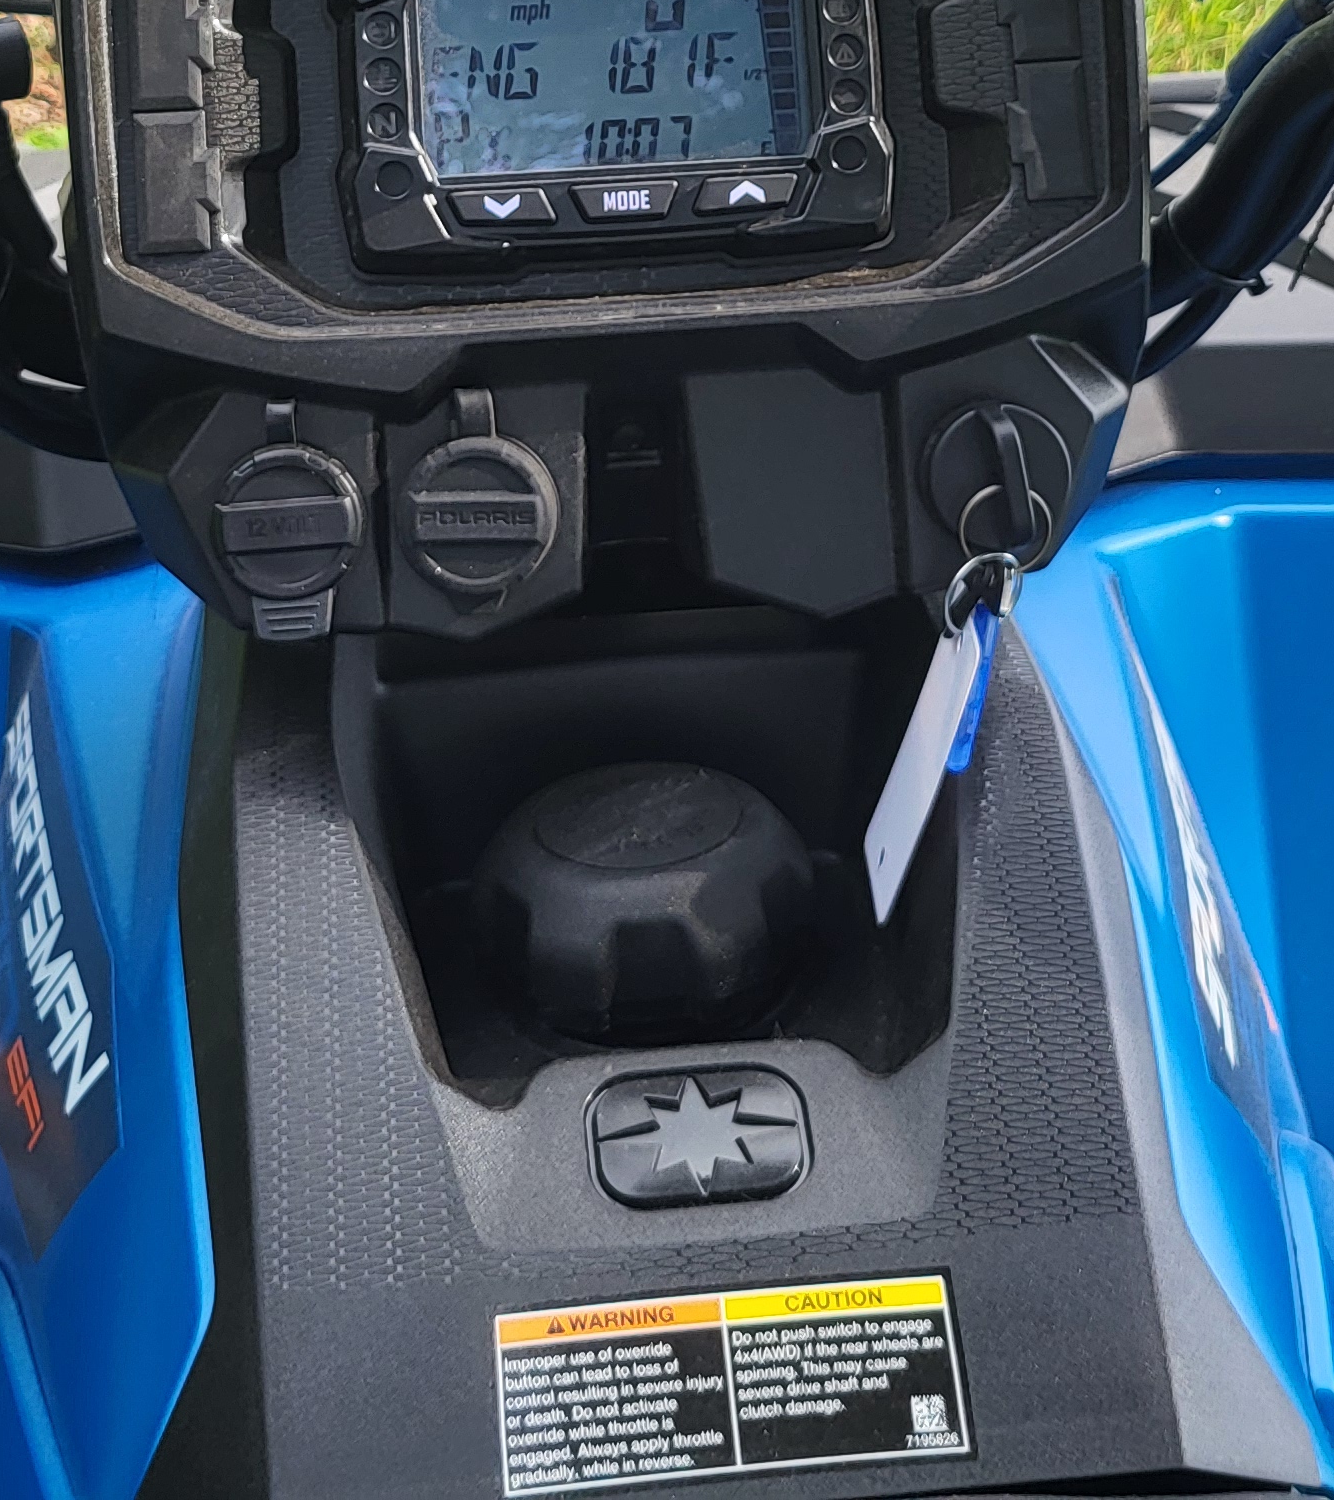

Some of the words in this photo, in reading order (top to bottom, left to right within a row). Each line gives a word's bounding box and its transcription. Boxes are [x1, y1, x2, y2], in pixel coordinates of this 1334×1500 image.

[602, 188, 651, 213] MODE
[419, 507, 536, 528] POLARIS
[3, 691, 109, 1116] SPORTSMAN
[785, 1288, 883, 1312] CAUTION
[569, 1306, 674, 1332] WARNING
[732, 1331, 753, 1345] Do
[755, 1328, 779, 1343] not
[781, 1324, 815, 1344] push
[817, 1320, 862, 1339] switch
[865, 1320, 880, 1335] to
[882, 1319, 932, 1336] engage
[504, 1353, 566, 1375] Improper
[569, 1351, 595, 1365] use
[597, 1346, 612, 1362] of
[615, 1341, 672, 1361] override
[732, 1342, 801, 1368] 4x4(AWD)
[804, 1342, 813, 1358] if
[815, 1341, 839, 1357] the
[841, 1341, 868, 1354] rear
[871, 1334, 920, 1352] wheels
[922, 1336, 943, 1349] are
[505, 1367, 550, 1390] button
[553, 1371, 579, 1385] can
[582, 1364, 613, 1382] lead
[615, 1364, 630, 1379] to
[633, 1362, 662, 1378] loss
[664, 1358, 679, 1374] of
[801, 1360, 831, 1376] This
[833, 1360, 862, 1378] may
[865, 1357, 907, 1371] cause
[506, 1387, 555, 1408] control
[557, 1384, 619, 1404] resulting
[620, 1381, 634, 1397] in
[637, 1380, 683, 1395] severe
[686, 1374, 723, 1393] injury
[737, 1385, 784, 1400] severe
[786, 1378, 821, 1396] drive
[824, 1375, 859, 1393] shaft
[862, 1373, 888, 1390] and
[506, 1414, 521, 1428] or
[572, 1405, 593, 1422] Do
[596, 1401, 620, 1418] not
[622, 1396, 678, 1416] activate
[739, 1401, 783, 1420] clutch
[508, 1427, 565, 1447] override
[569, 1422, 605, 1440] while
[607, 1416, 659, 1436] throttle
[662, 1415, 675, 1431] is
[577, 1441, 629, 1458] Always
[631, 1434, 669, 1454] apply
[673, 1429, 724, 1449] throttle
[582, 1459, 619, 1478] while
[623, 1457, 636, 1473] in
